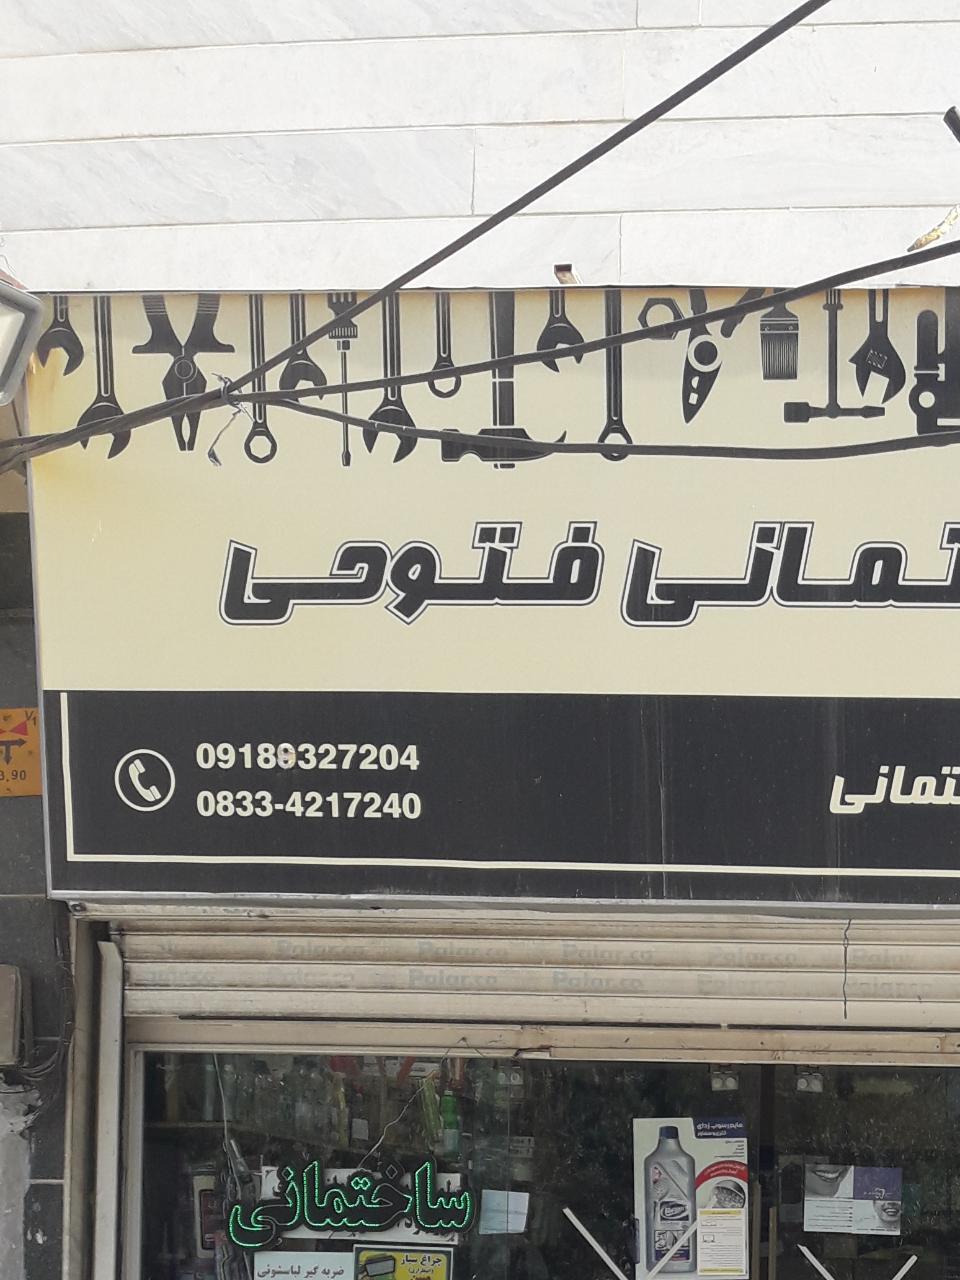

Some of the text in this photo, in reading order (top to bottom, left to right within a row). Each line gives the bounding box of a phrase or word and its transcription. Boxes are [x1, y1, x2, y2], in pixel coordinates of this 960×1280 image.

[219, 520, 605, 626] فتوحی
[196, 790, 422, 819] 0833-4217240
[228, 1159, 471, 1247] ساختمانی
[321, 1265, 345, 1279] ضربه
